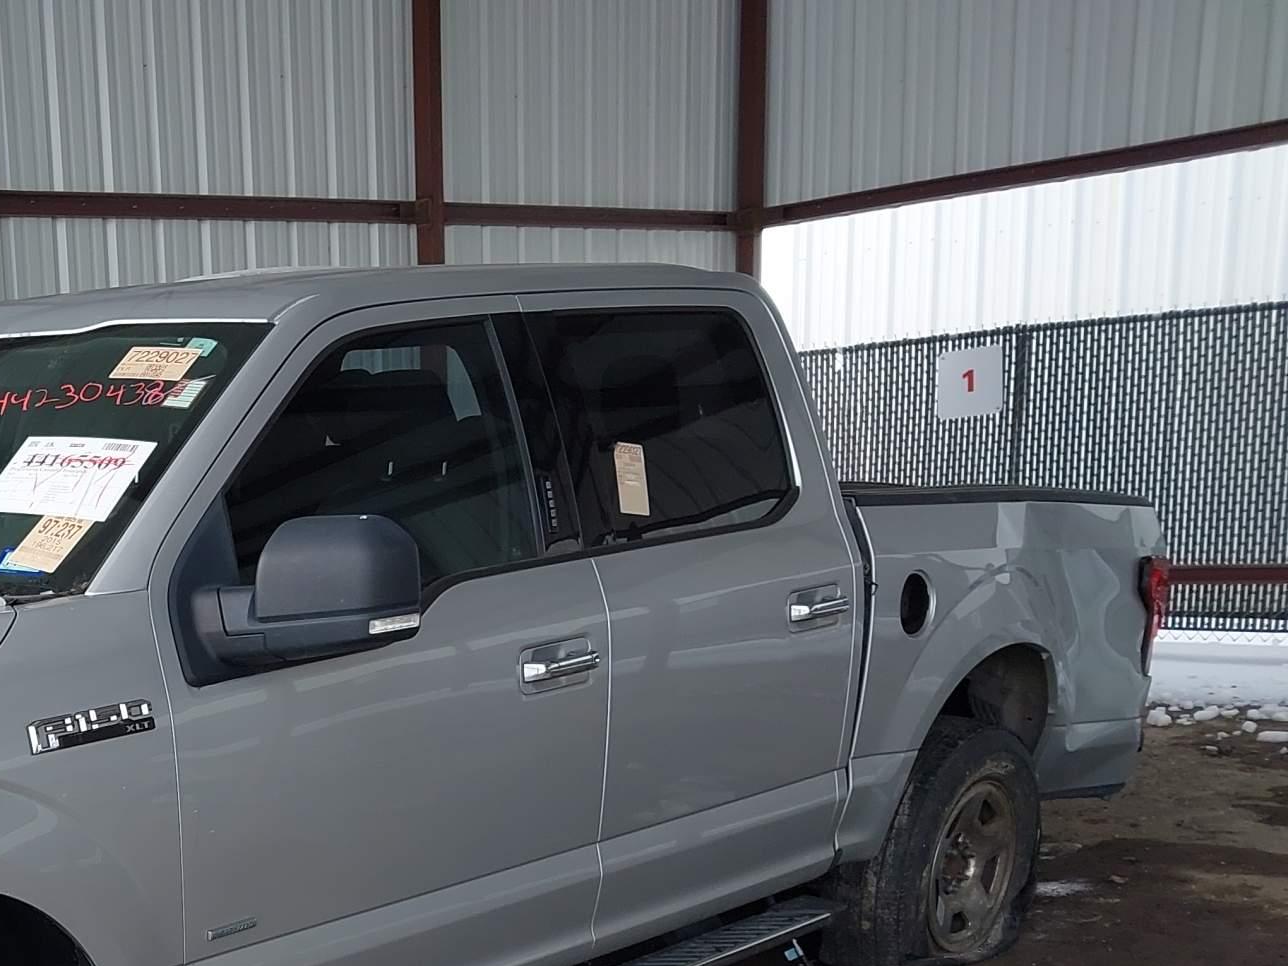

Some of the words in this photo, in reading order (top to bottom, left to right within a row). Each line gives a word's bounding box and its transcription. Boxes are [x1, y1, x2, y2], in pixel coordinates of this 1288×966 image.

[127, 350, 198, 364] 7229027
[962, 369, 974, 393] 1
[125, 721, 151, 734] XLT
